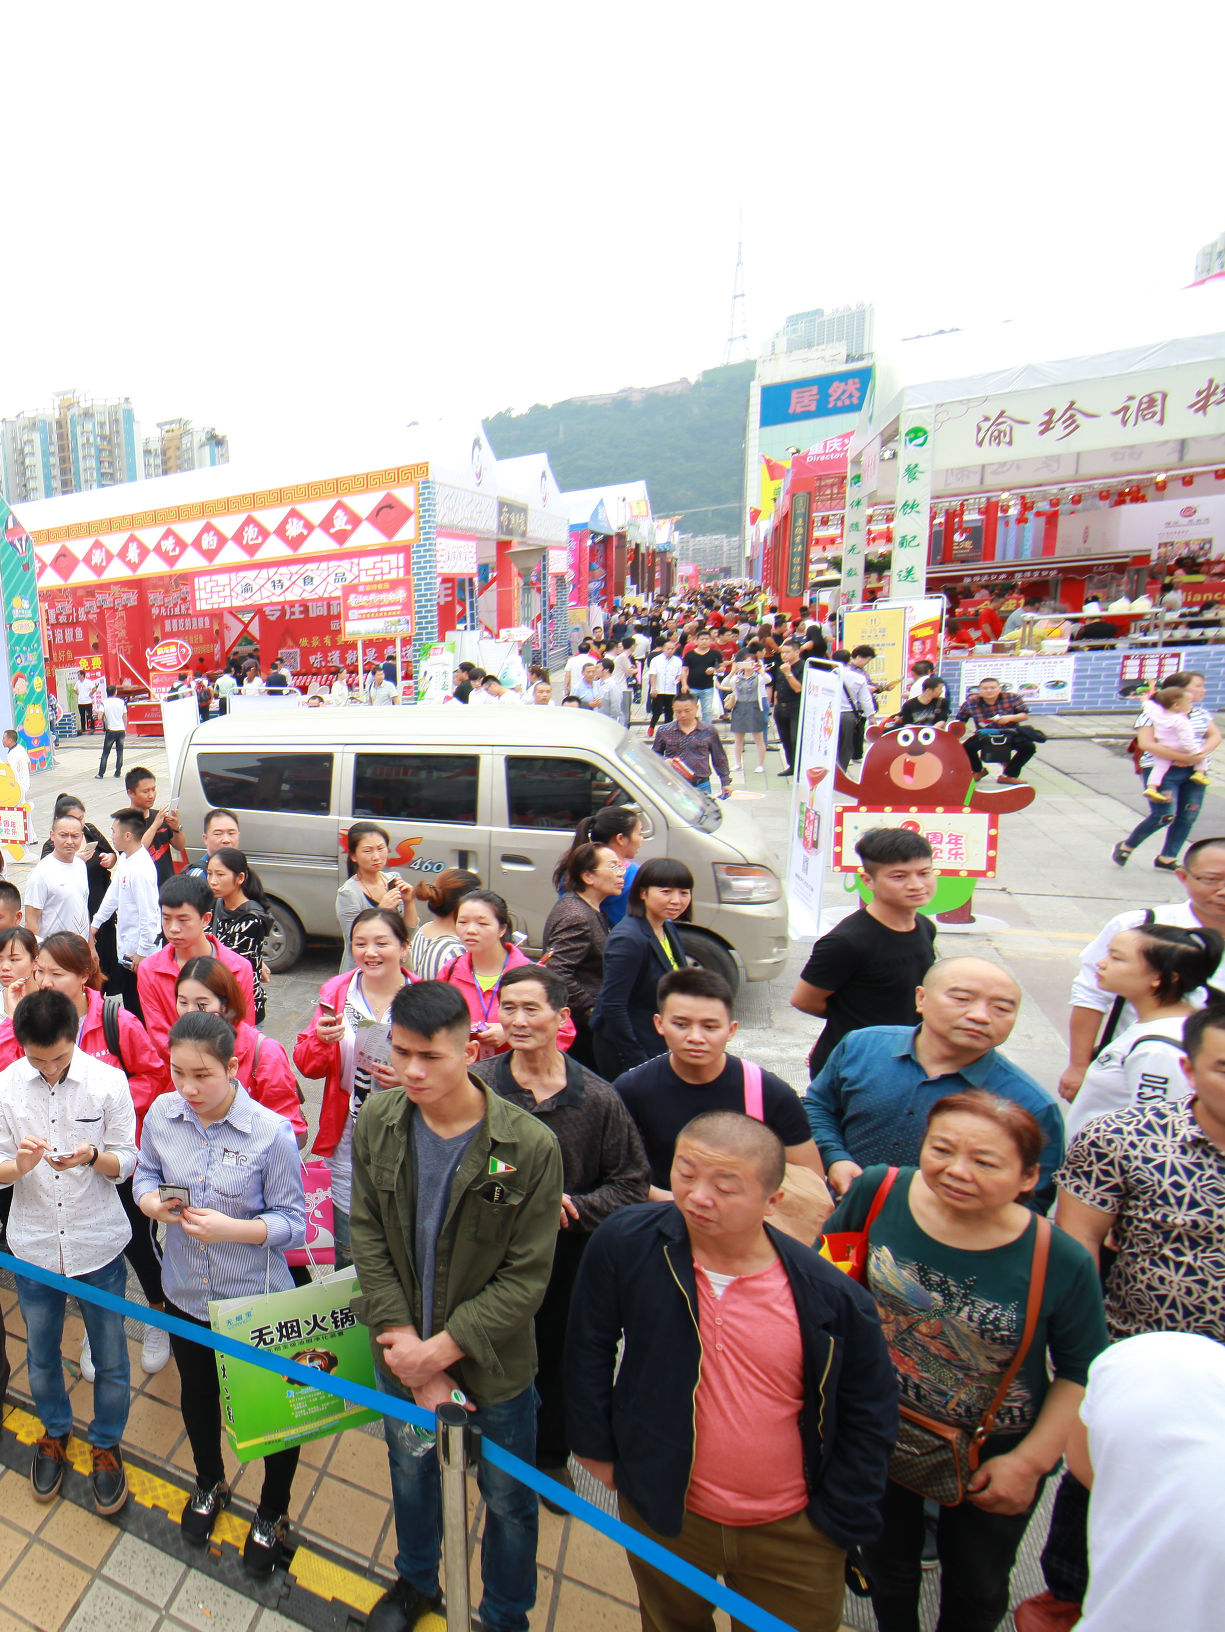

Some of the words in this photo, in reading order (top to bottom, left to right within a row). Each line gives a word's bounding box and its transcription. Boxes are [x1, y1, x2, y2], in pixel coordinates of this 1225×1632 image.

[788, 378, 862, 414] 居然
[806, 452, 844, 463] Director
[896, 462, 926, 583] 餐饮配送
[240, 571, 348, 594] 渝特食品
[409, 857, 447, 873] 460
[1136, 1072, 1170, 1104] DES
[249, 1307, 357, 1348] 无烟火锅
